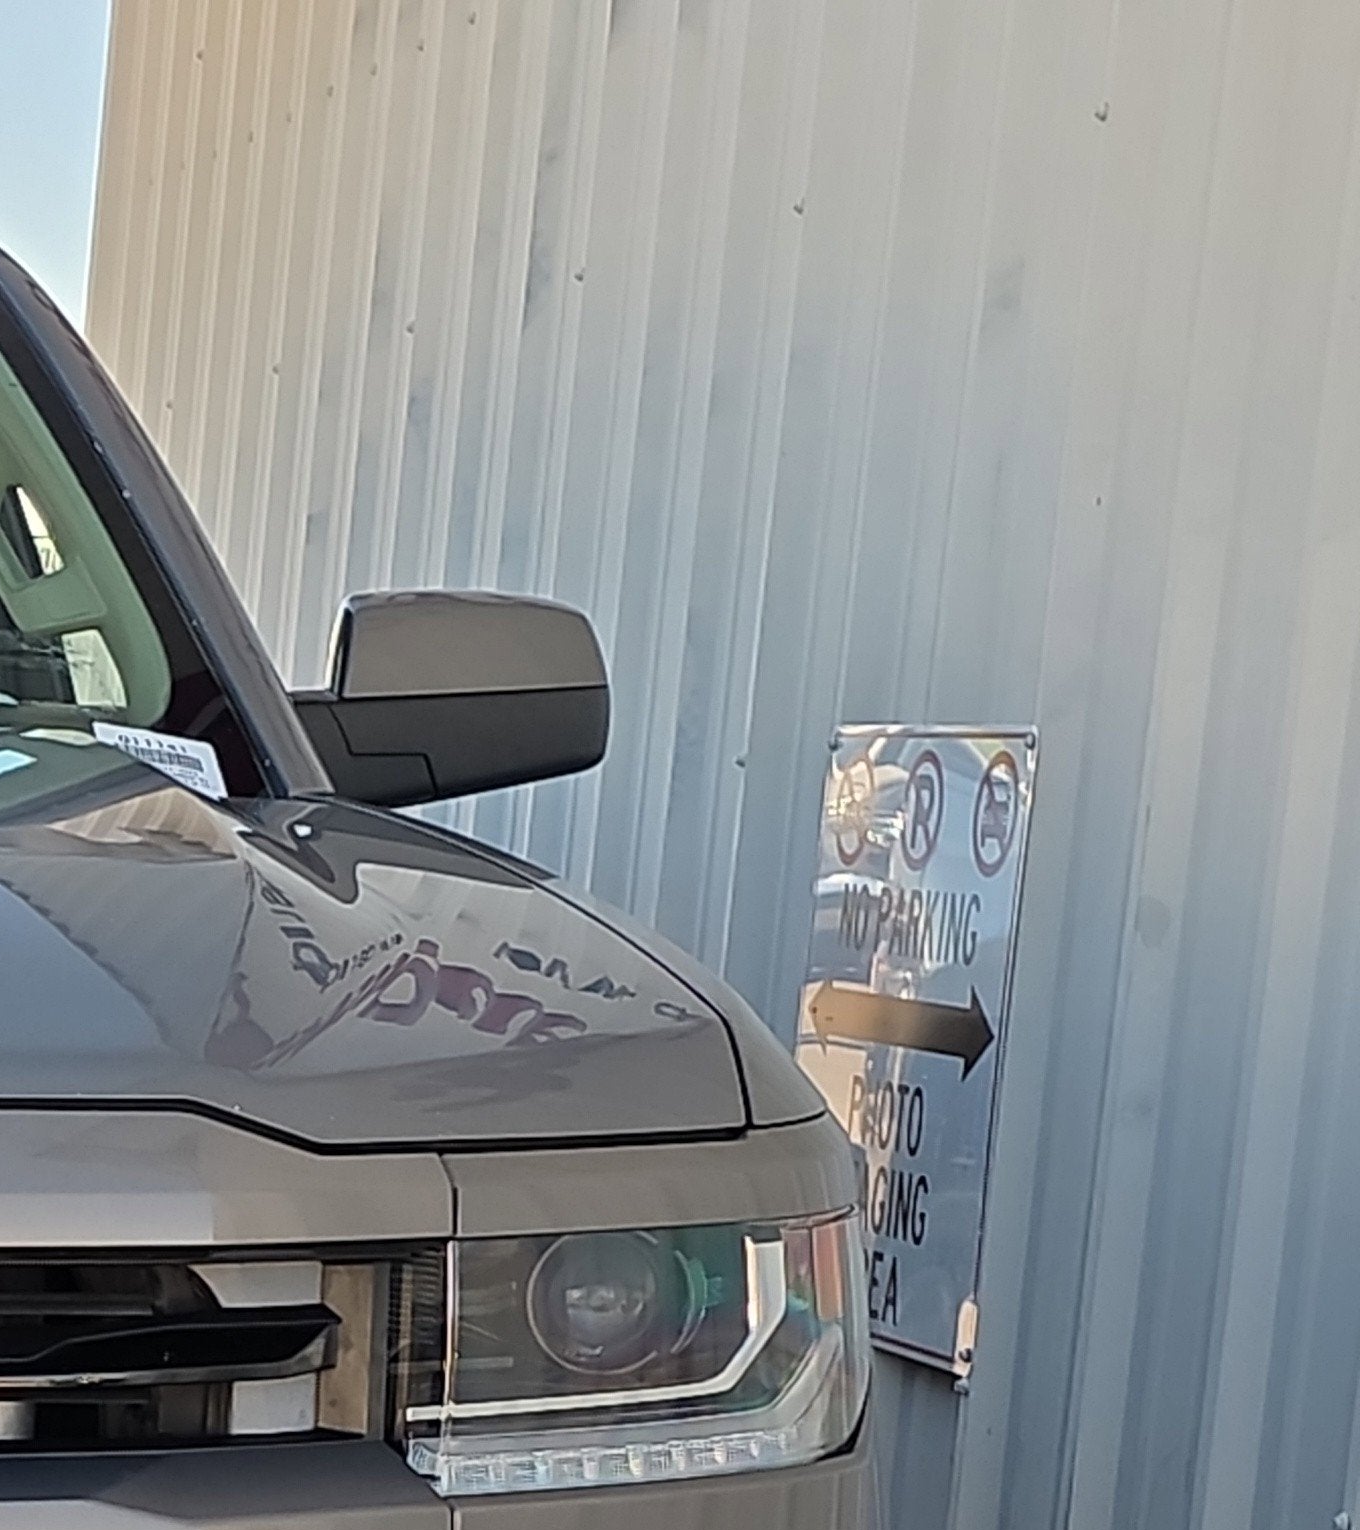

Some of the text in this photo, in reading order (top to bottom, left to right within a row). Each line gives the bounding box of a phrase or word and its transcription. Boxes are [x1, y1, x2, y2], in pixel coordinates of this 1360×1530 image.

[839, 883, 981, 966] NO PARKING
[847, 1074, 924, 1157] PHOTO
[864, 1248, 899, 1327] EA
